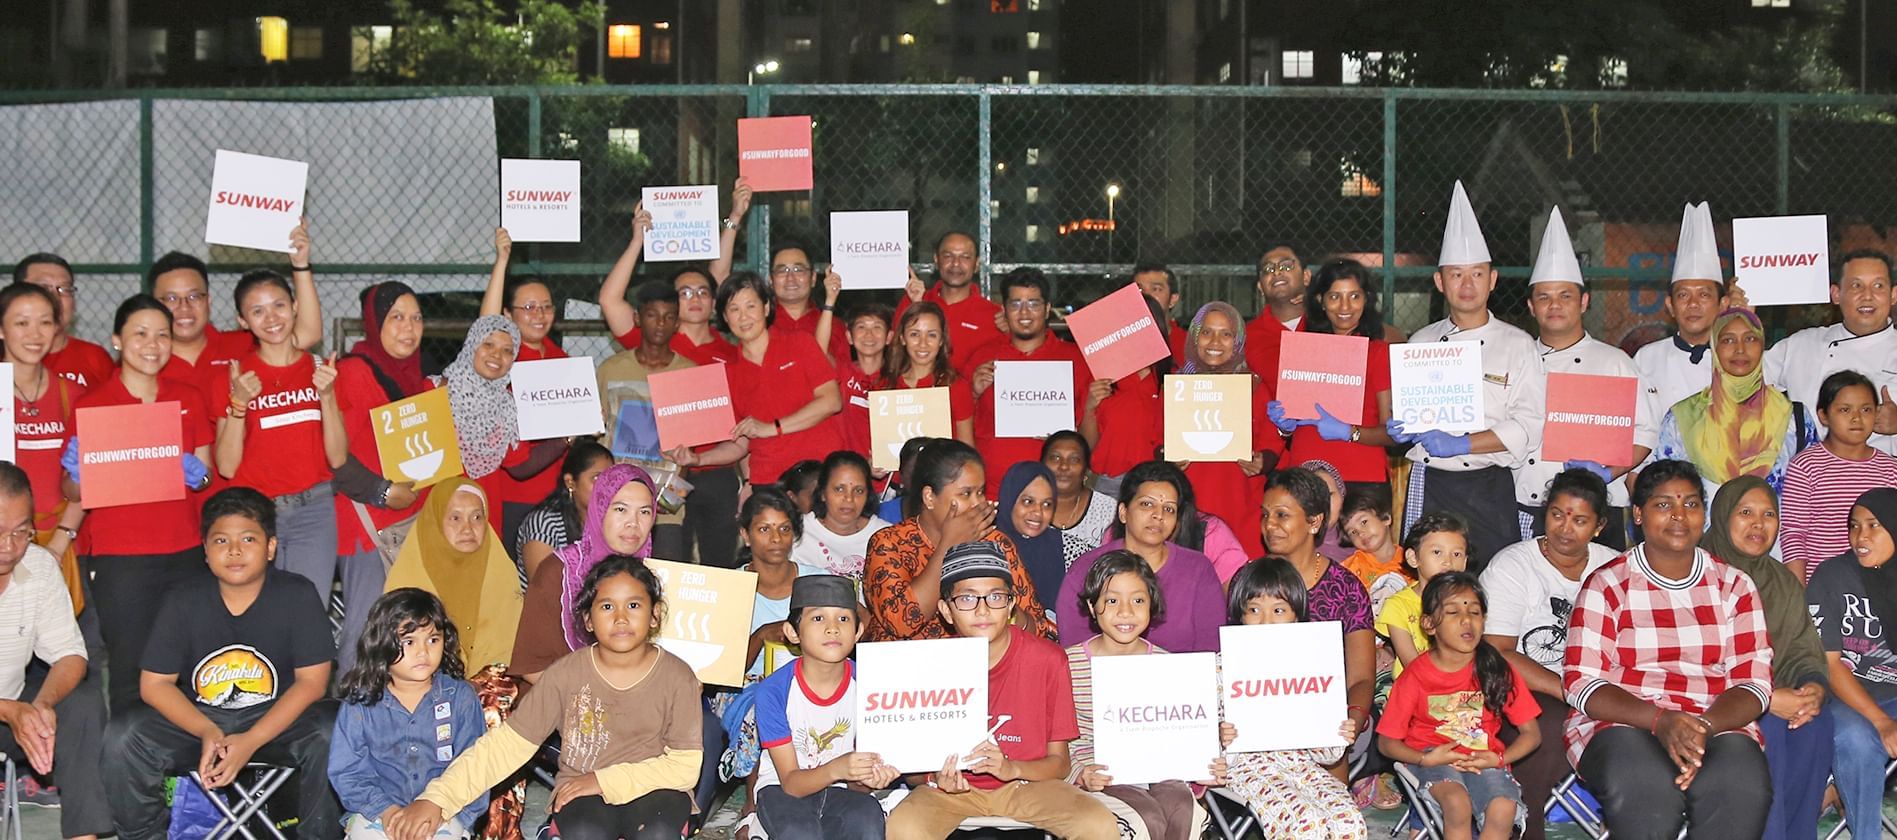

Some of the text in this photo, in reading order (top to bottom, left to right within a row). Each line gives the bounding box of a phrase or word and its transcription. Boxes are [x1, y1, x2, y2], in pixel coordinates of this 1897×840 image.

[742, 148, 809, 160] #SUNWAYFORGOOD
[215, 191, 295, 213] SUNWAY
[507, 190, 572, 202] SUNWAY
[653, 191, 703, 201] SUNWAY
[650, 229, 711, 239] DEVELOPMENT
[651, 238, 712, 255] GOALS
[846, 242, 902, 253] KECHARA
[1740, 253, 1819, 269] SUNWAY
[1083, 316, 1152, 357] #SUNWAYFORGOOD
[1402, 347, 1464, 360] SUNWAY
[1402, 360, 1450, 368] COMMITTED
[1193, 380, 1213, 390] ZERO
[1281, 369, 1362, 386] #SUNWAYFORGOOD
[530, 387, 591, 402] KECHARA
[1010, 391, 1067, 401] KECHARA
[1174, 380, 1185, 401] 2
[1193, 391, 1224, 402] HUNGER
[1400, 384, 1475, 396] SUSTAINABLE
[657, 396, 729, 417] #SUNWAYFORGOOD
[879, 396, 889, 416] 2
[1400, 395, 1474, 407] DEVELOPMENT
[381, 410, 395, 435] 2
[1402, 405, 1476, 425] GOALS
[1547, 411, 1632, 427] #SUNWAYFORGOOD
[83, 445, 180, 465] #SUNWAYFORGOOD
[680, 571, 706, 586] ZERO
[678, 586, 718, 604] HUNGER
[1230, 676, 1334, 698] SUNWAY
[865, 688, 975, 711] SUNWAY
[864, 713, 905, 724] HOTELS
[919, 710, 967, 721] RESORTS
[1119, 704, 1208, 723] KECHARA
[997, 733, 1022, 743] Jeans
